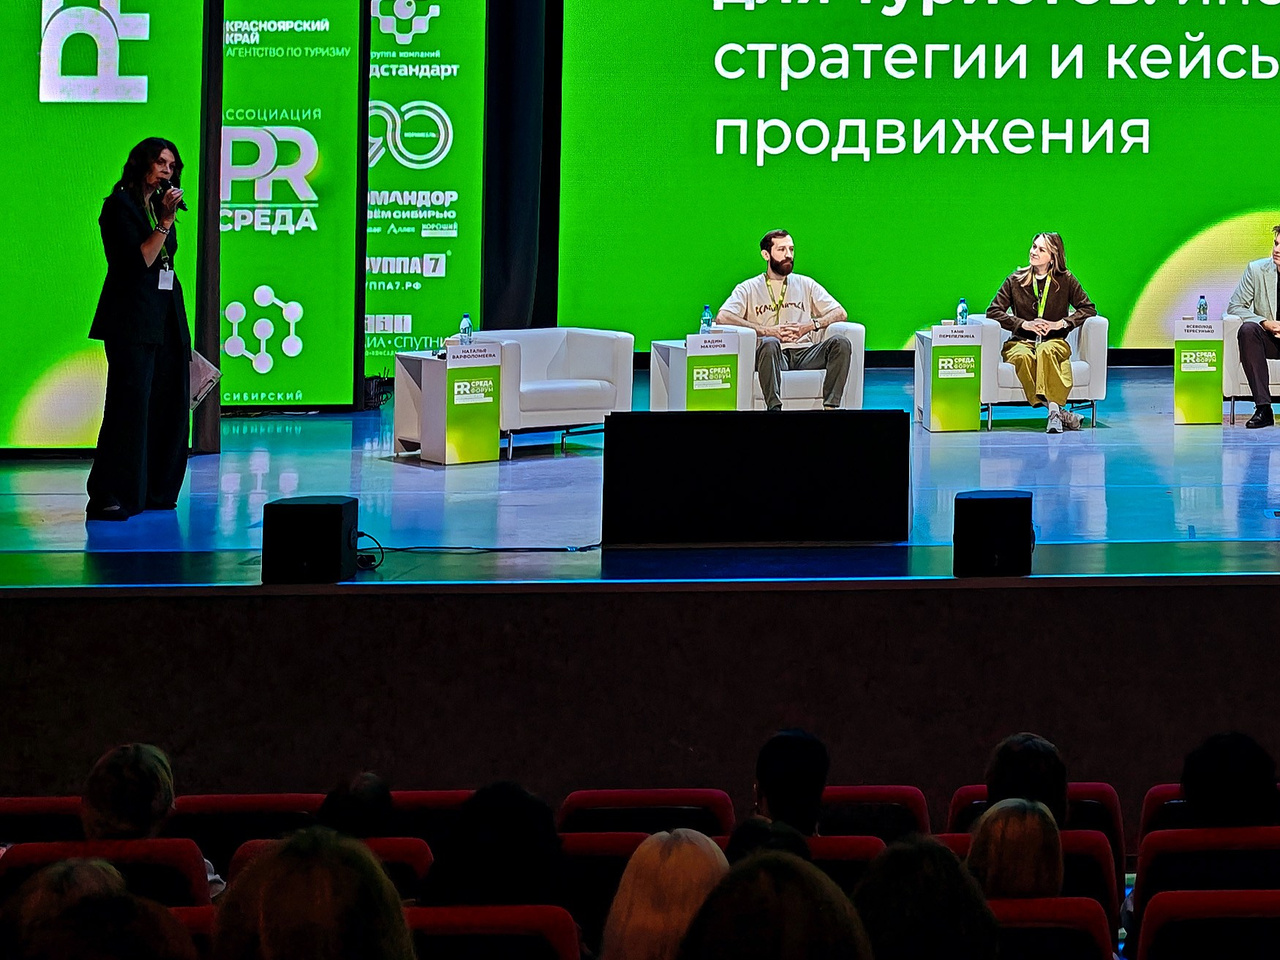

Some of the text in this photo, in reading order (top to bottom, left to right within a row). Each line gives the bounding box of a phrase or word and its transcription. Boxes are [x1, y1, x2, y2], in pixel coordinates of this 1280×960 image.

[225, 18, 330, 33] КРАСНОЯРСКИЙ
[225, 32, 260, 45] КРАЙ
[226, 47, 351, 58] АГЕНТСТВО ПО ТУРИЗМУ
[370, 51, 396, 59] руппа
[369, 64, 460, 80] дстандарт
[714, 42, 1027, 90] стратегии
[1052, 43, 1083, 80] и
[223, 108, 322, 122] ССОЦИАЦИЯ
[715, 118, 1150, 166] продвижения
[221, 126, 319, 201] PR
[368, 190, 458, 207] МАНДОР
[220, 209, 318, 235] СРЕДА
[366, 257, 421, 274] УППА
[365, 281, 421, 290] ППА7.РФ
[223, 390, 303, 402] СИБИРСКИЙ
